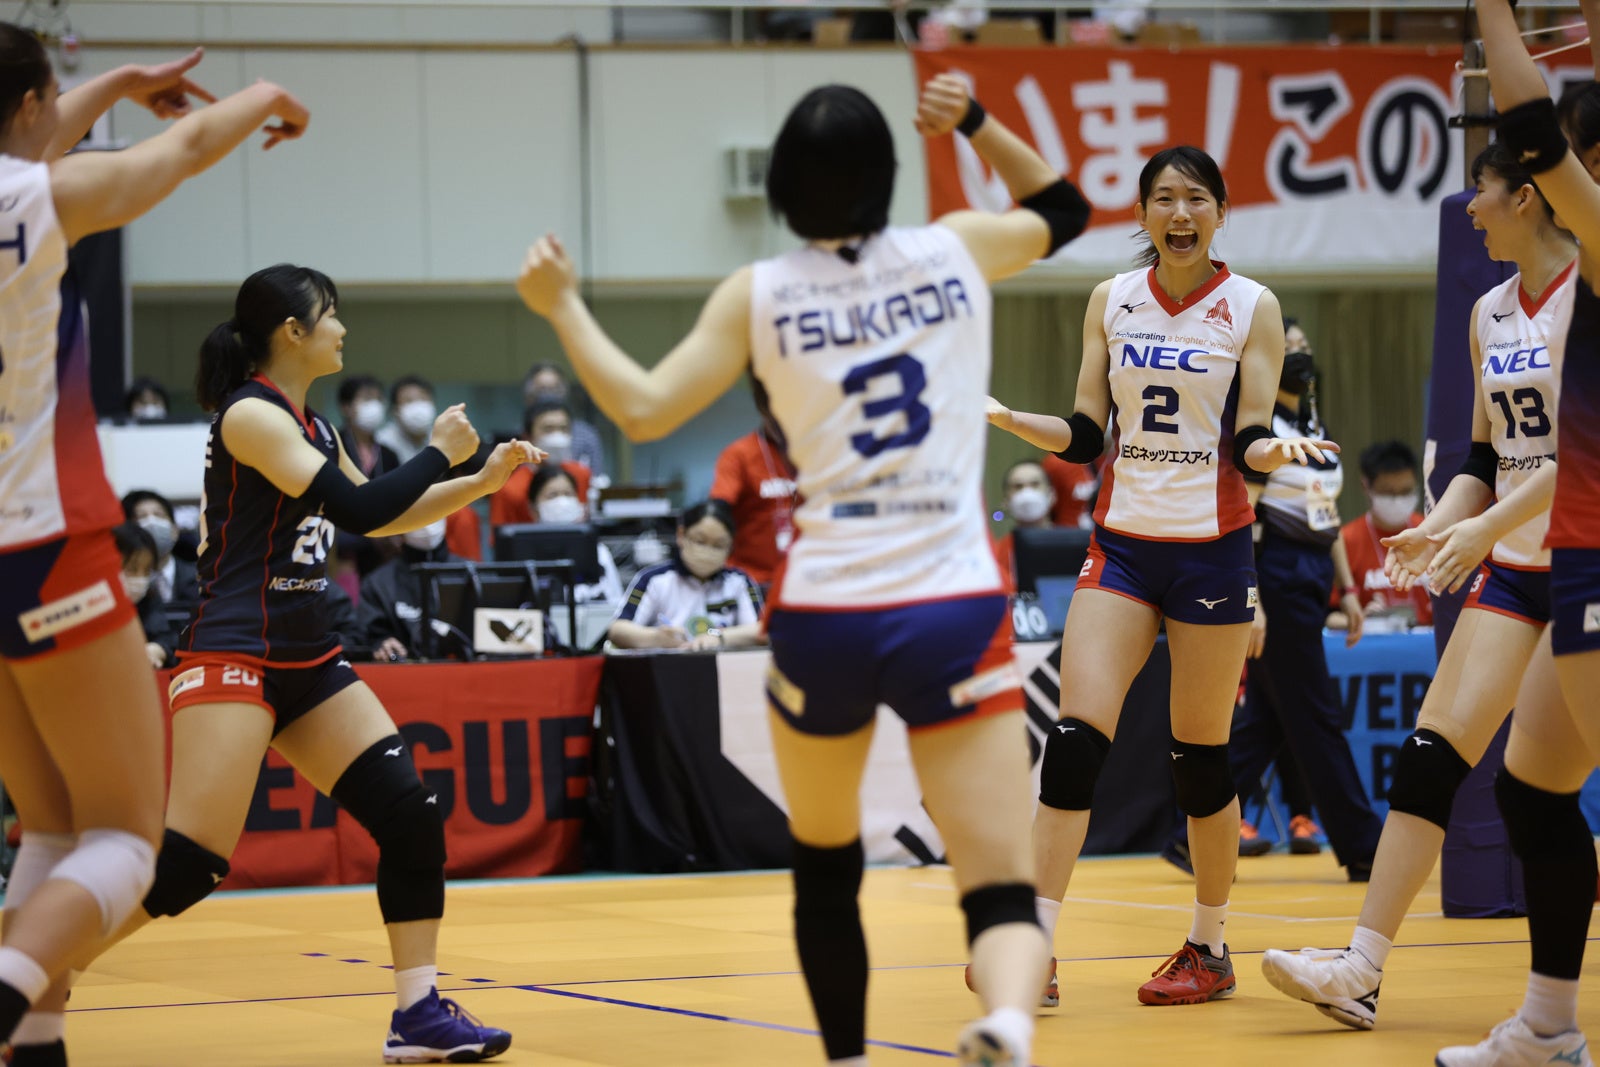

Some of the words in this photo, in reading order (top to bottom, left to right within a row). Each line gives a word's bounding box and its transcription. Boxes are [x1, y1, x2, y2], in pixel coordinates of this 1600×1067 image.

[773, 277, 974, 359] TSUKADA
[1114, 332, 1166, 342] rchestrating
[1120, 343, 1210, 373] NEC
[1483, 345, 1551, 377] NEC
[841, 352, 932, 459] 3
[1142, 384, 1180, 435] 2
[1490, 387, 1552, 439] 13
[1079, 559, 1094, 577] 2
[222, 663, 259, 686] 20
